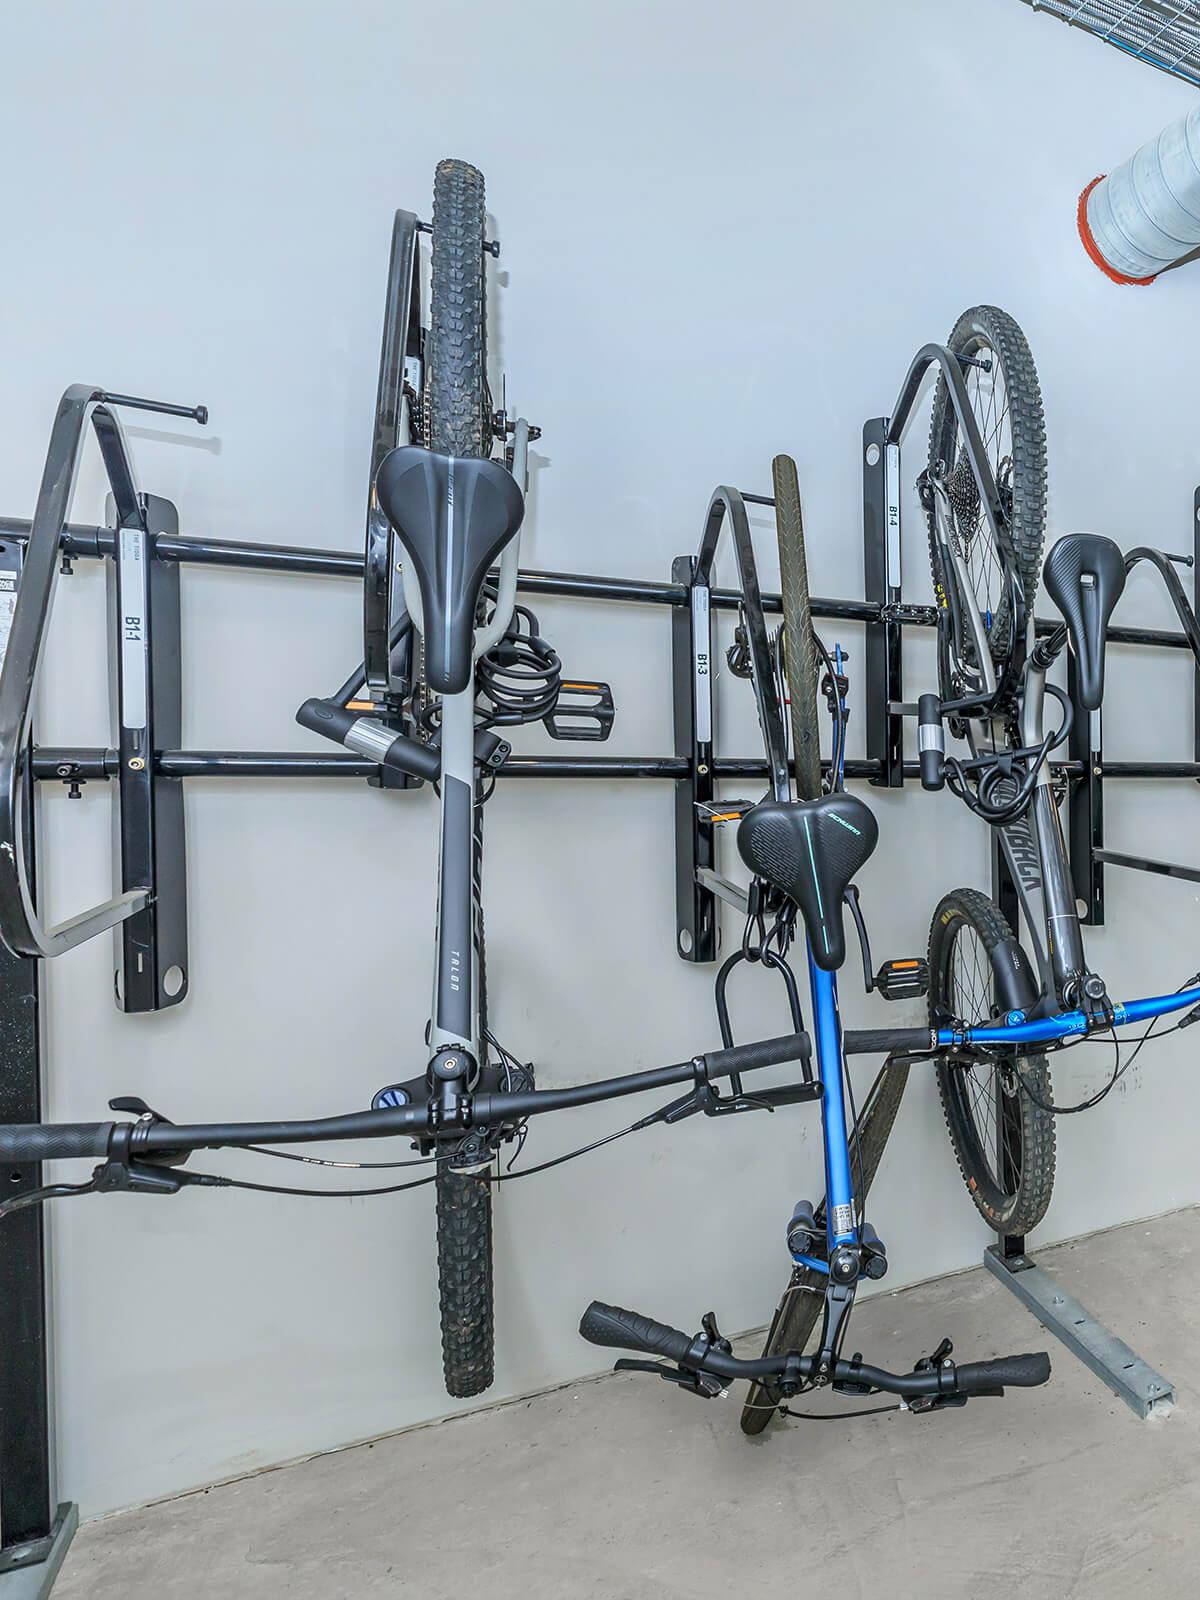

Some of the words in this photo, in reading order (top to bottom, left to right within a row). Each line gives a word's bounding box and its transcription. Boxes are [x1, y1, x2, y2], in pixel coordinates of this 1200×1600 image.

[889, 505, 898, 526] B1-4
[125, 617, 141, 641] B1-1
[697, 653, 708, 675] B1-3
[450, 950, 461, 991] TALON
